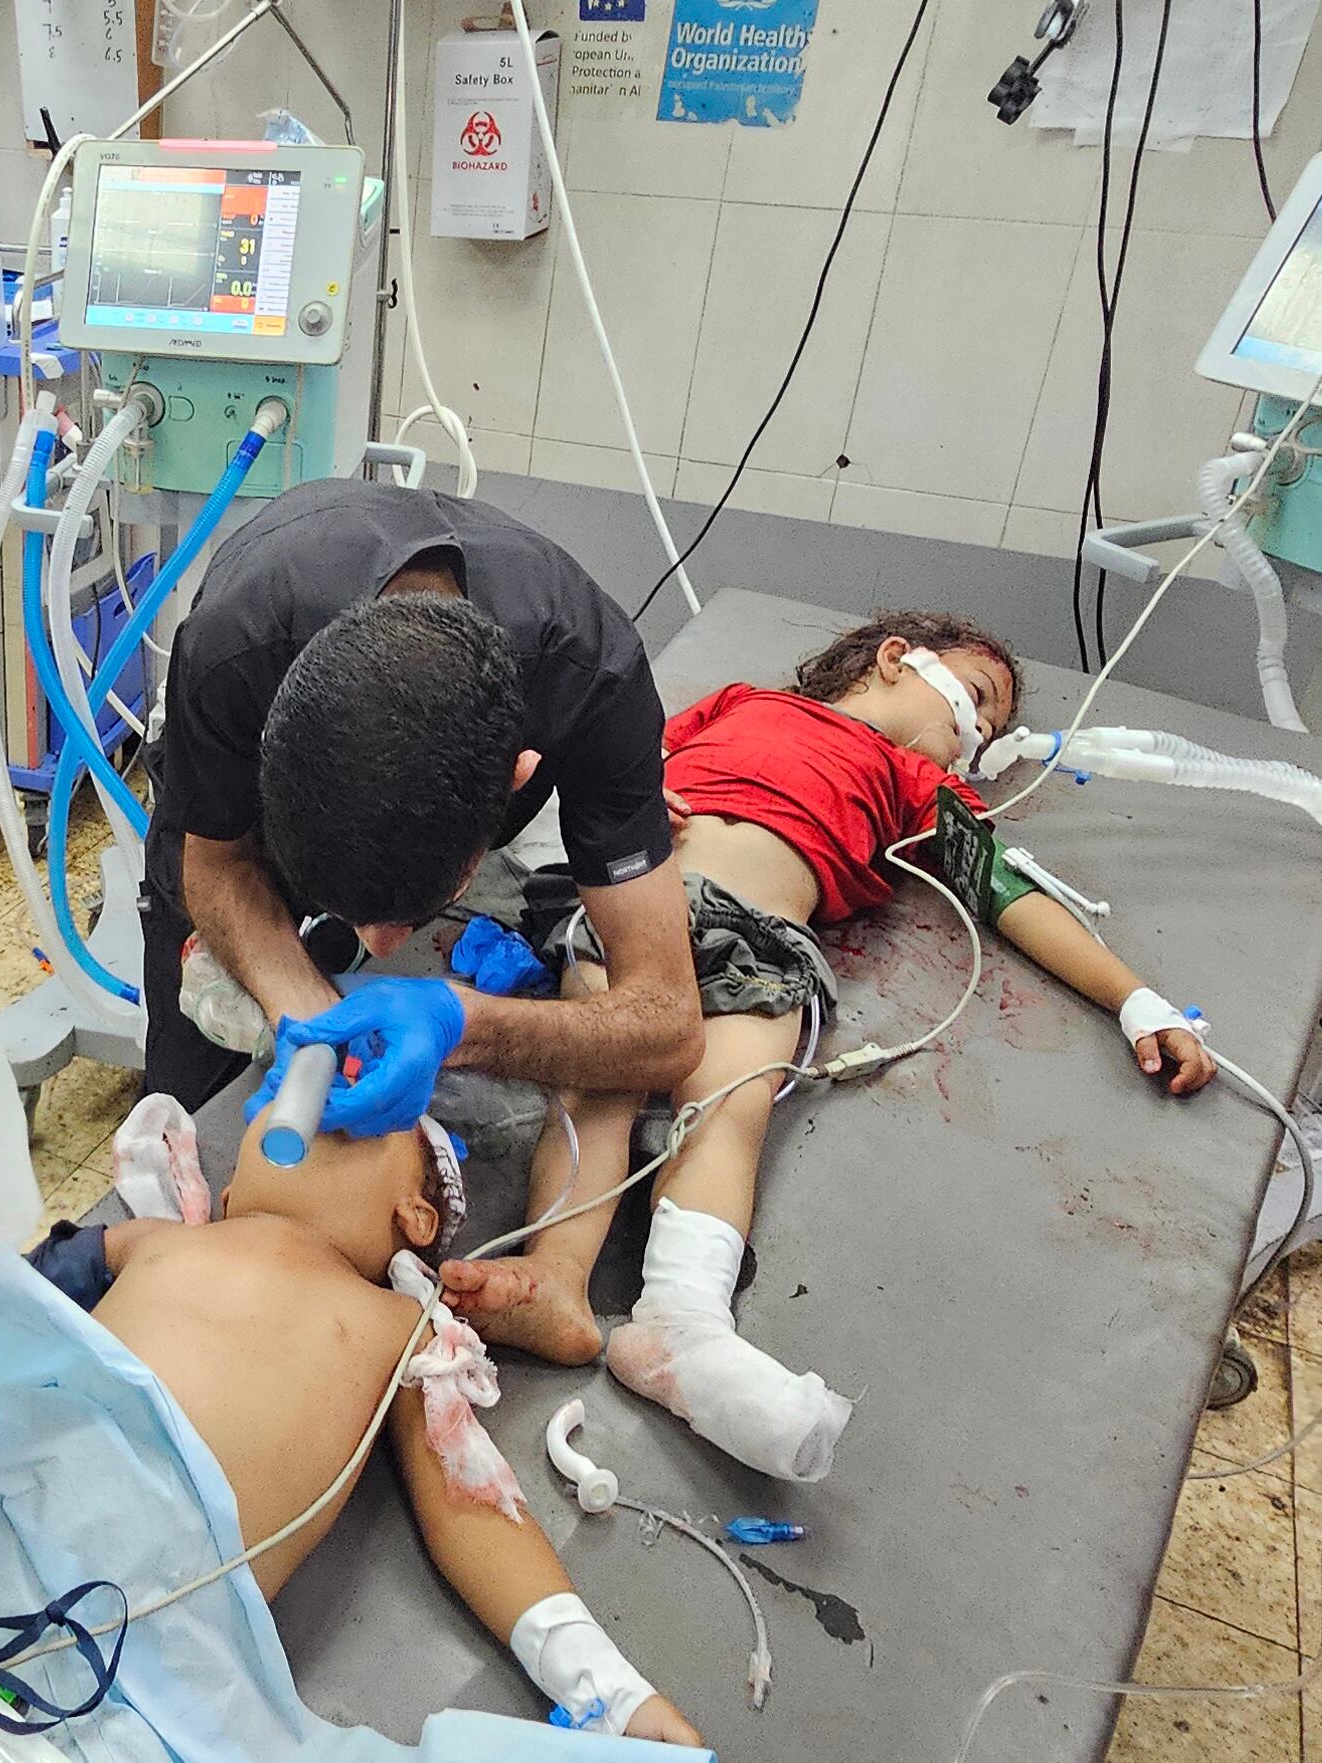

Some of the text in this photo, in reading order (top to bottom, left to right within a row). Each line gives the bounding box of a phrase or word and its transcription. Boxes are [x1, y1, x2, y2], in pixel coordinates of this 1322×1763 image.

[103, 10, 123, 26] 5.5
[42, 23, 63, 41] 7.5
[105, 27, 112, 40] 6
[678, 22, 806, 48] World Health
[105, 46, 123, 63] 6.5
[499, 57, 514, 68] 5L
[671, 47, 803, 75] Organization
[572, 66, 631, 78] Protection
[455, 74, 514, 88] Safety Box
[231, 280, 252, 297] 0.0
